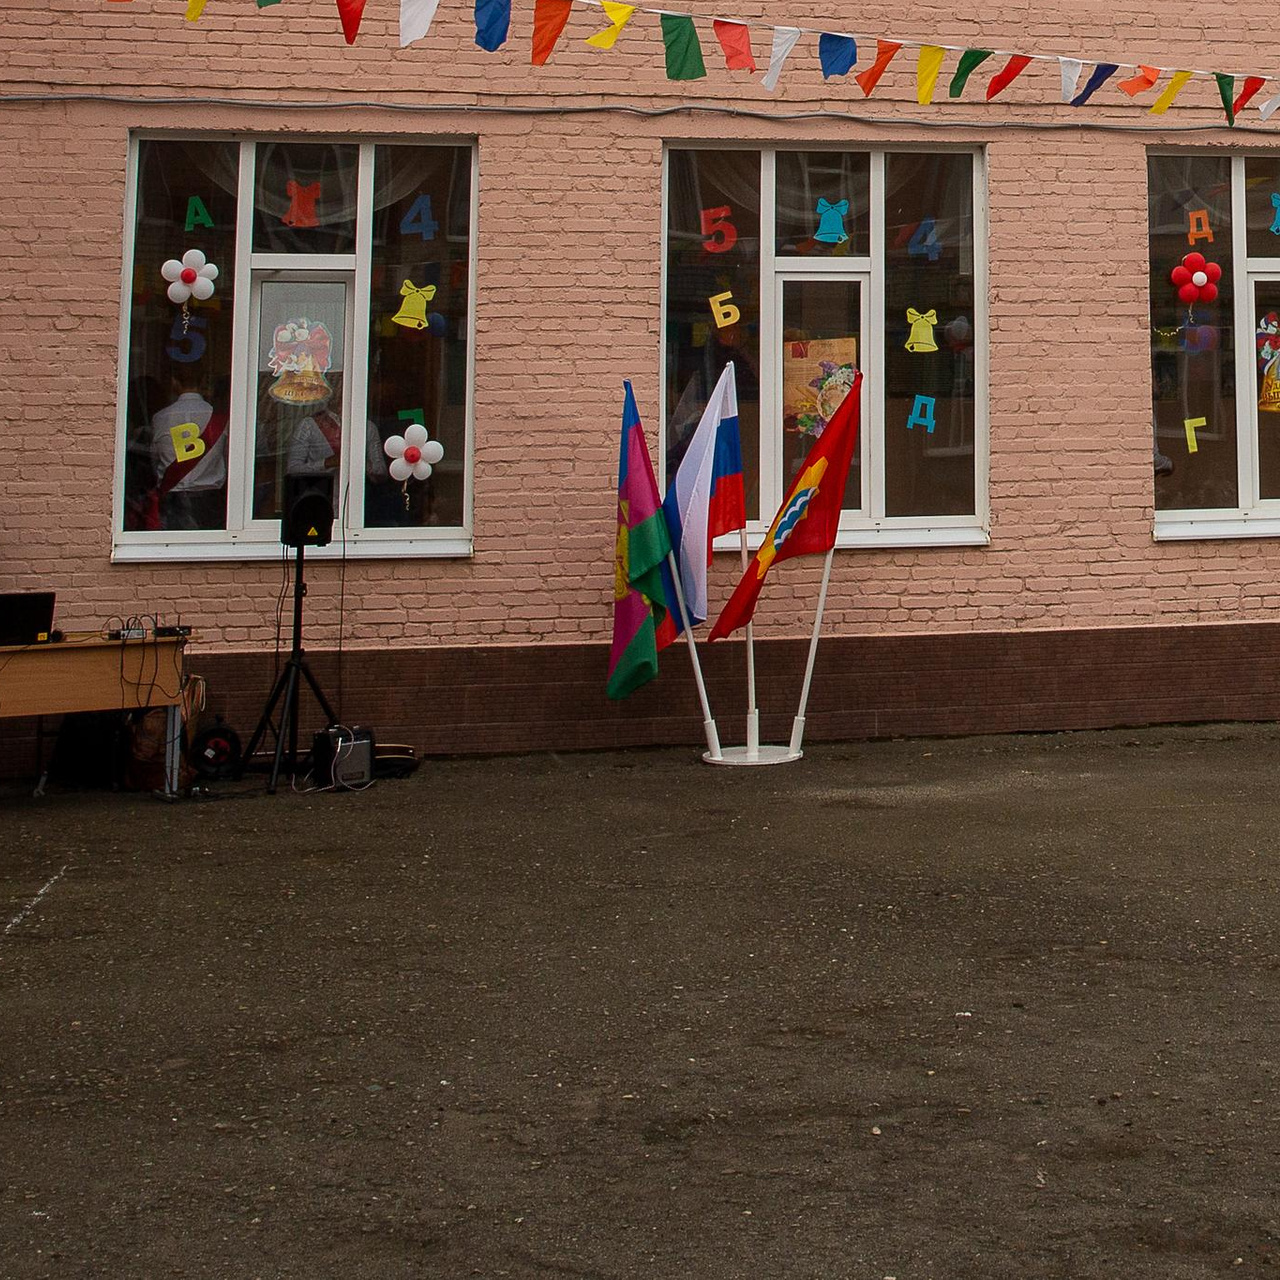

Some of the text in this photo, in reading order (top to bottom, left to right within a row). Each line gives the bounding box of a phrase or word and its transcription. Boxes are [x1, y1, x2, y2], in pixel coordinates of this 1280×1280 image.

[185, 195, 214, 232] А
[400, 194, 439, 241] 4
[700, 206, 738, 253] 5
[1188, 209, 1213, 246] Д
[907, 214, 942, 261] 4
[708, 290, 740, 329] Б
[165, 315, 206, 363] 5
[906, 394, 936, 434] Д
[170, 422, 206, 462] В
[1183, 417, 1207, 454] Г
